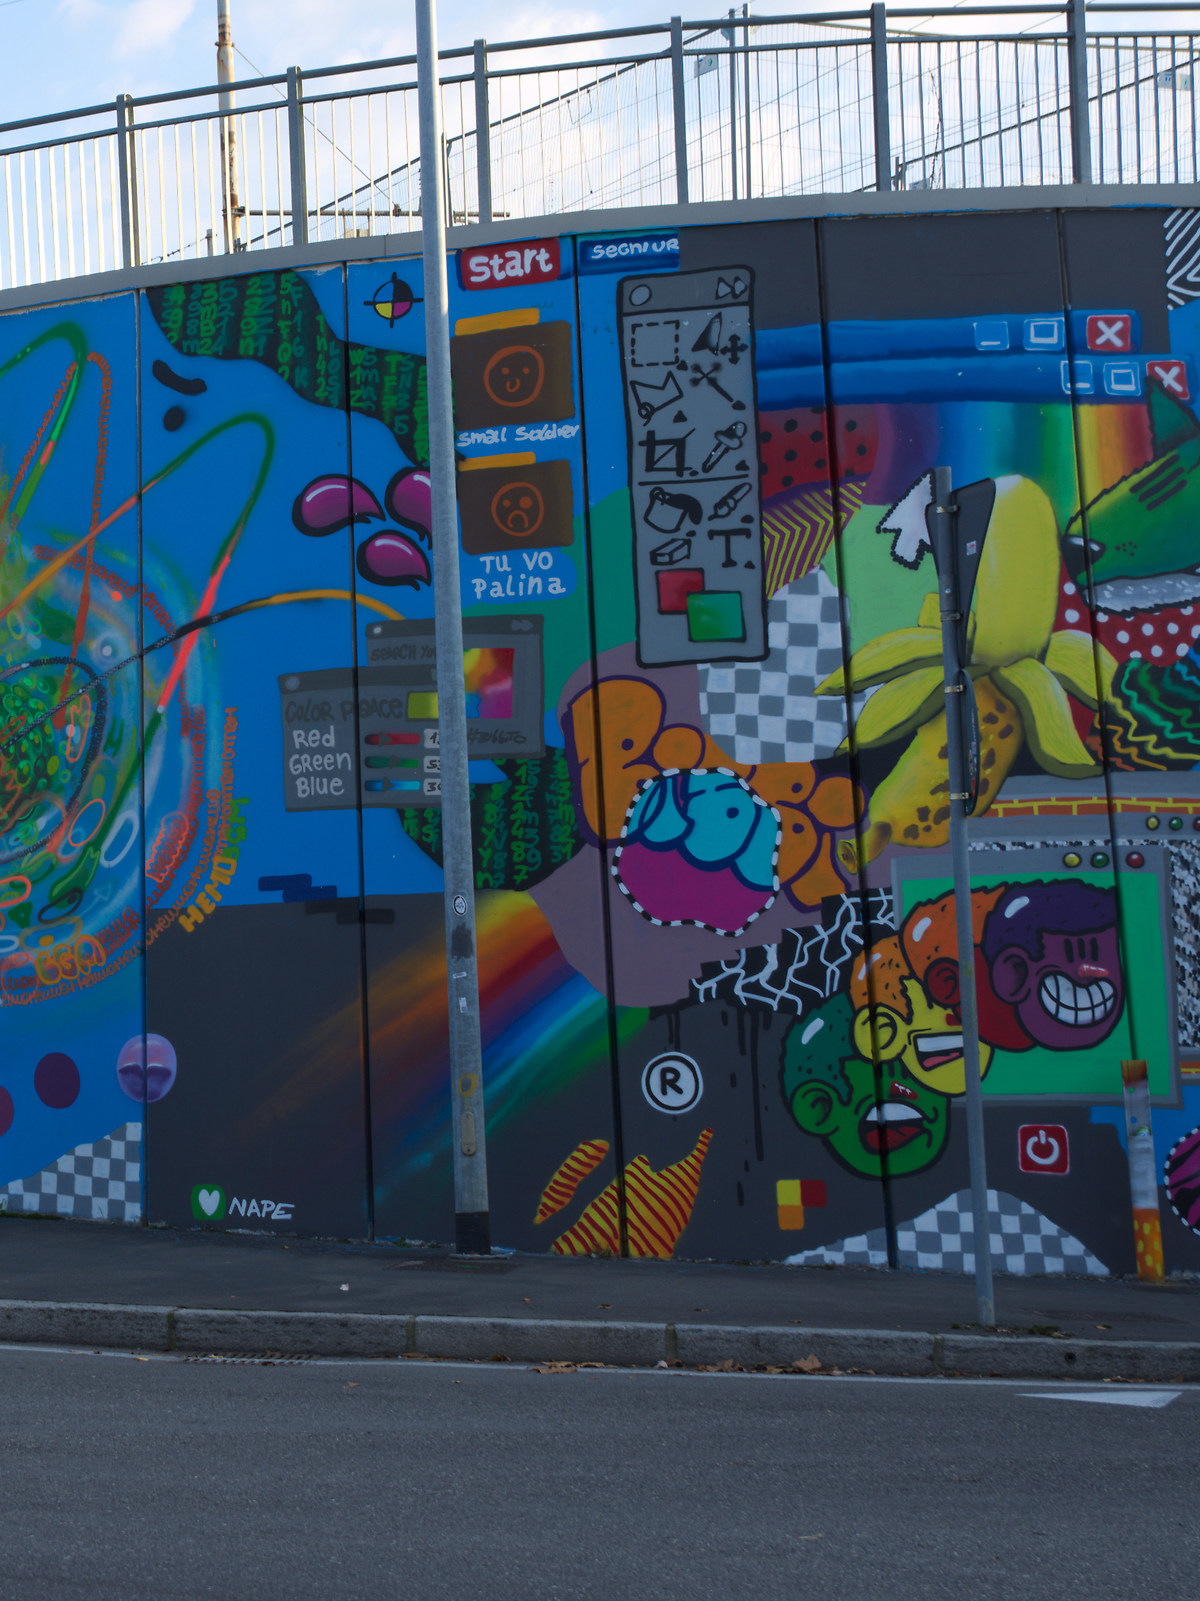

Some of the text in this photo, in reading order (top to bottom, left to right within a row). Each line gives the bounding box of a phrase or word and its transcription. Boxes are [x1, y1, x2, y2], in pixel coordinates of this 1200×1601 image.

[469, 247, 553, 282] Start
[480, 551, 553, 574] TU VO
[471, 572, 567, 600] Palina
[293, 725, 335, 749] Red
[296, 775, 345, 798] Blue
[228, 1196, 296, 1220] NAPE
